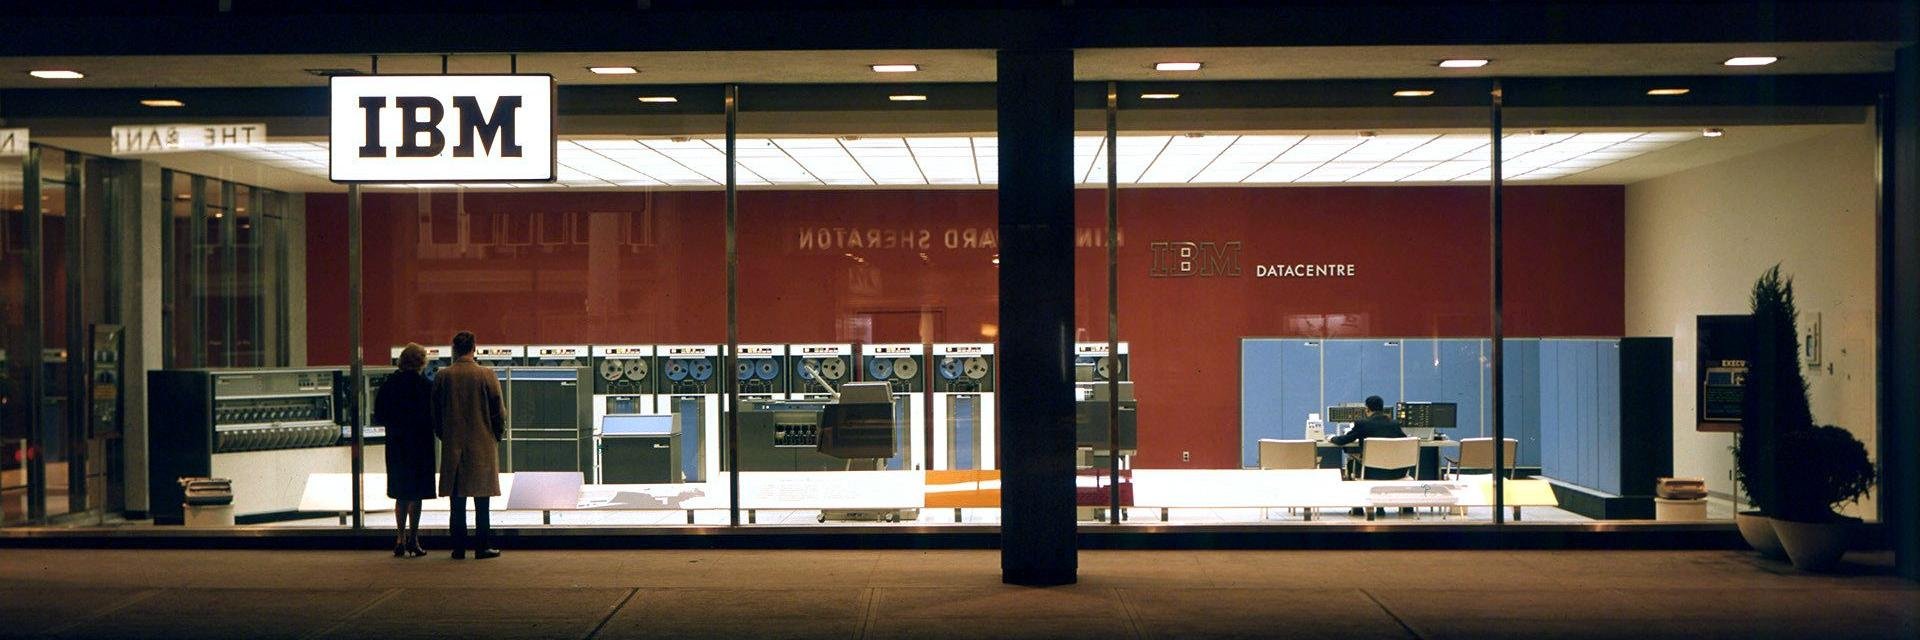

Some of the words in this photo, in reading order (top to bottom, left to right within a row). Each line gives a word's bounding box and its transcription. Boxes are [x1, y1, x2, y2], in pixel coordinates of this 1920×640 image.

[359, 96, 522, 157] IBM
[1150, 241, 1242, 277] IBM
[1256, 264, 1356, 277] DATACENTRE
